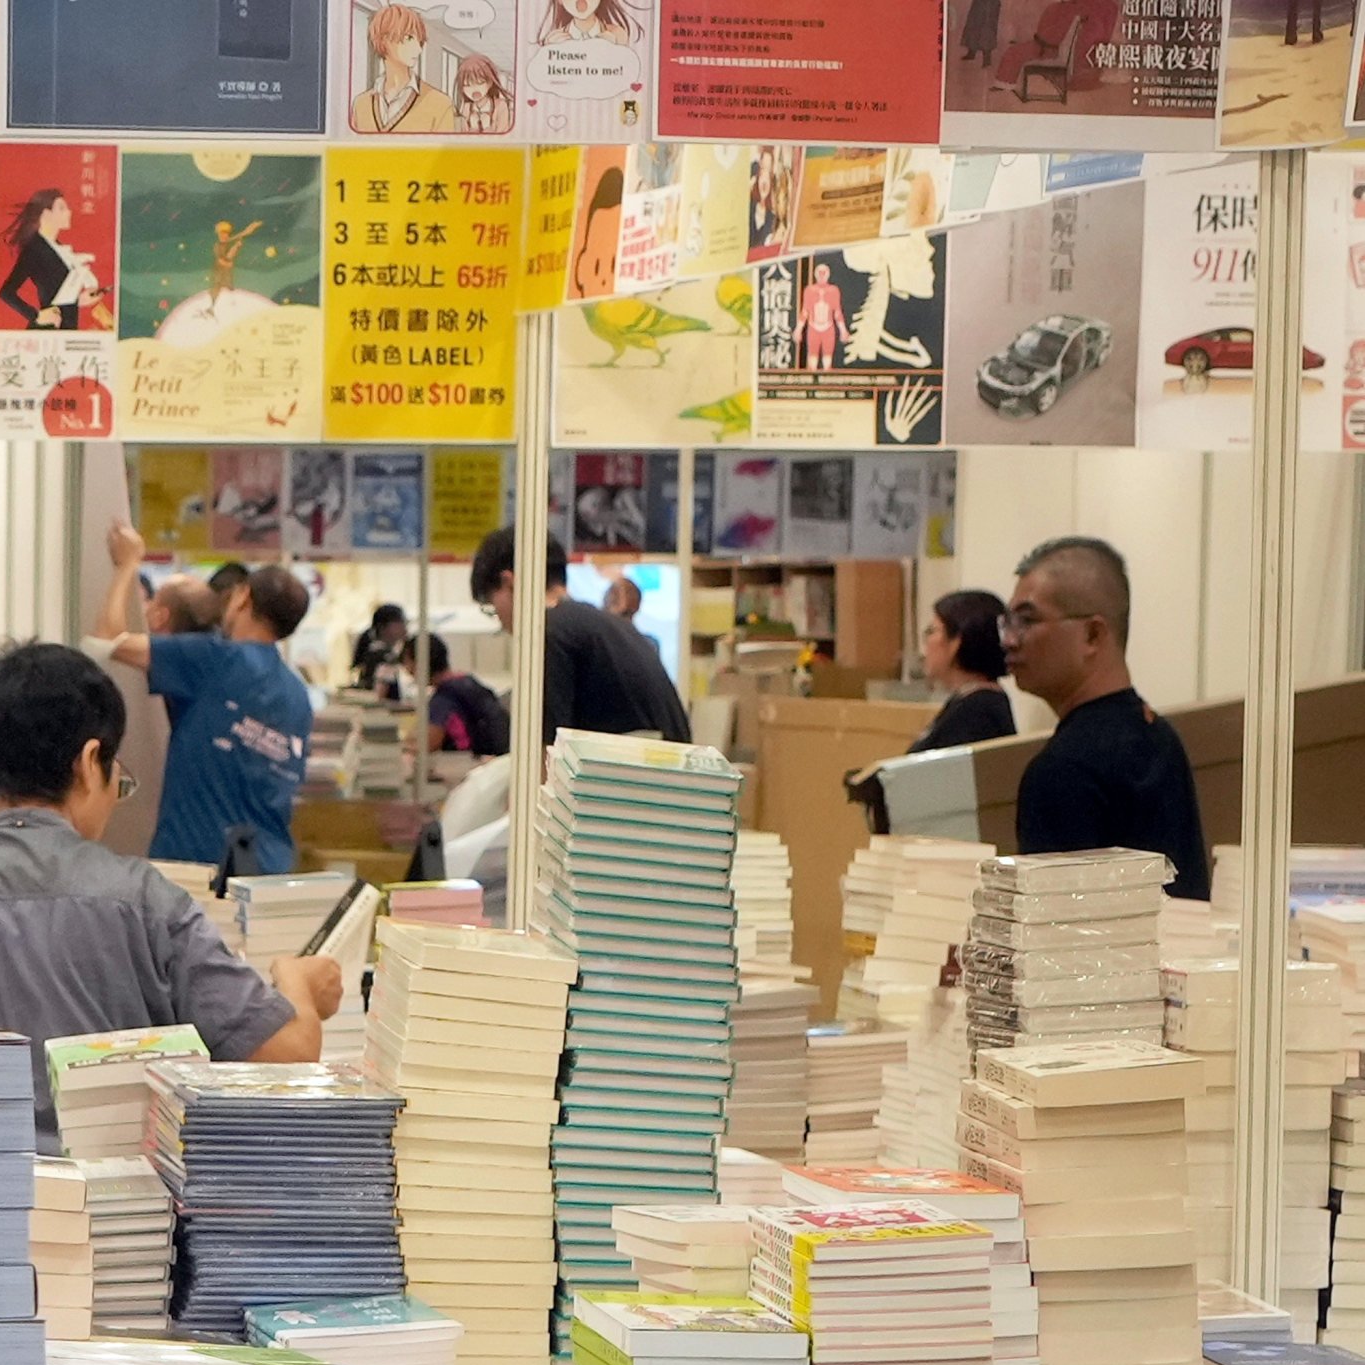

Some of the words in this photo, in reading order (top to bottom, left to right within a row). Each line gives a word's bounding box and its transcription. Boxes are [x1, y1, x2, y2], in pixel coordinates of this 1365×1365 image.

[1122, 0, 1221, 17] 超值隨書附
[1122, 20, 1221, 42] 中國十大名
[548, 50, 587, 61] Please
[548, 64, 579, 76] listen
[582, 65, 595, 76] to
[598, 65, 624, 77] me!
[336, 181, 346, 202] 1
[366, 181, 391, 203] 至
[334, 222, 348, 245] 3
[366, 223, 390, 245] 至
[333, 264, 446, 288] 6本或以上
[349, 308, 489, 332] 特價書除外
[132, 351, 159, 370] Le
[409, 345, 485, 367] LABEL)
[132, 377, 182, 394] Petit
[331, 385, 347, 404] 滿
[351, 382, 404, 406] $100
[408, 386, 425, 405] 送
[132, 399, 201, 418] Prince
